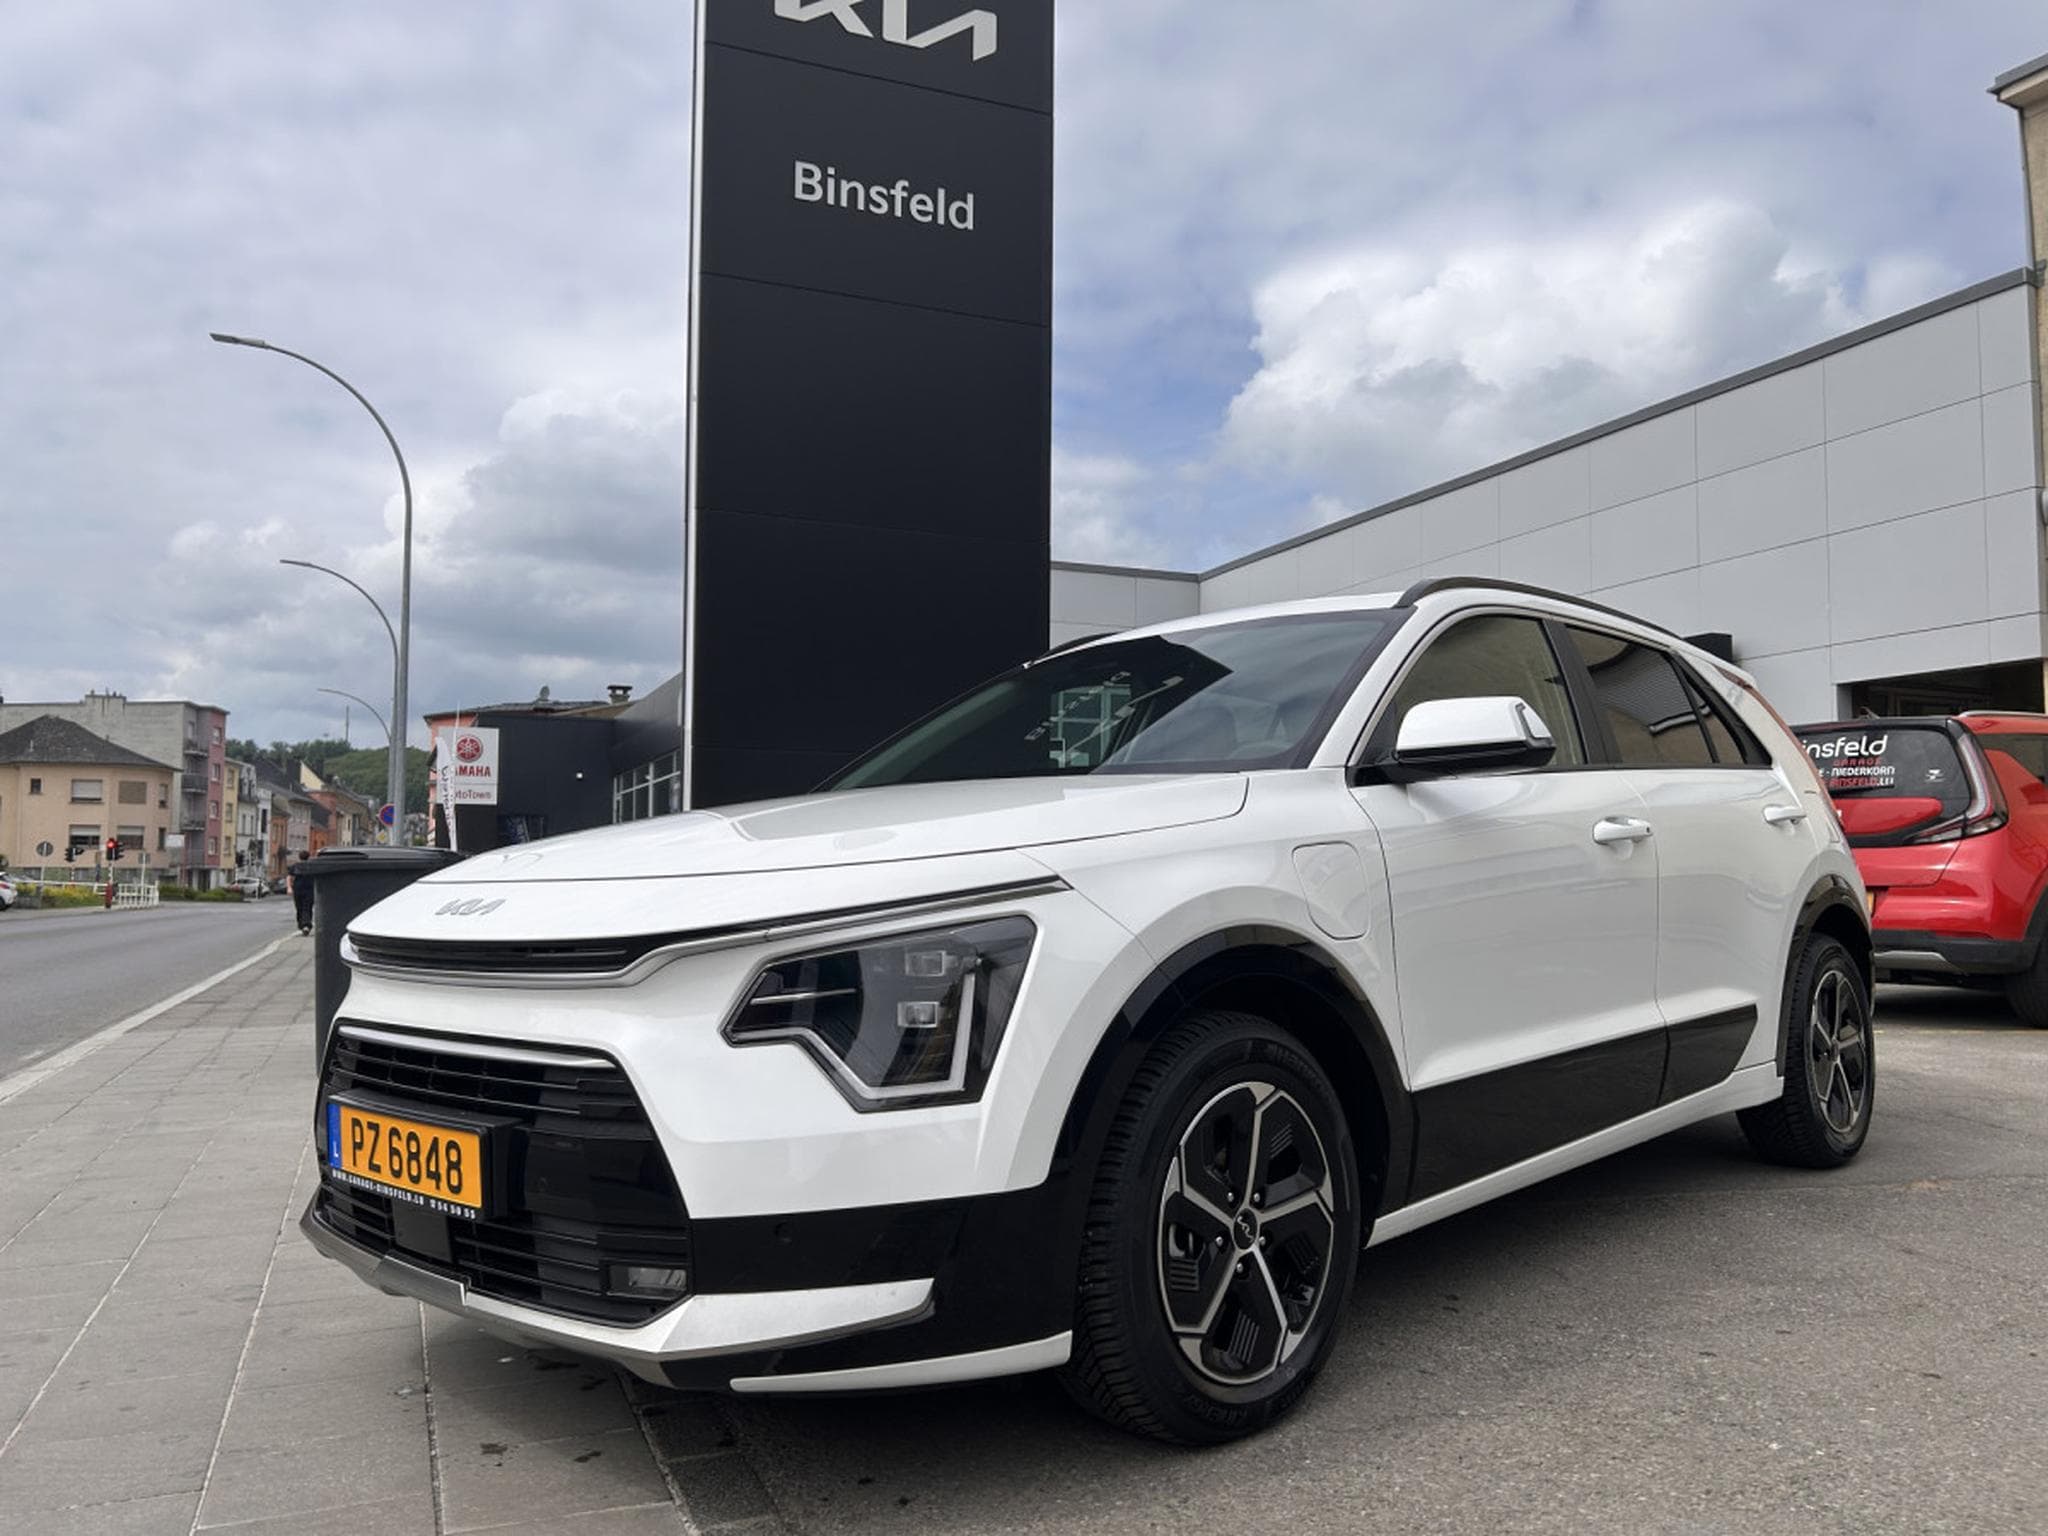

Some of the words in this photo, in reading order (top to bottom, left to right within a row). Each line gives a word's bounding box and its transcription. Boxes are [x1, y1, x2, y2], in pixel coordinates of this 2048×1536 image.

[794, 160, 975, 231] Binsfeld
[1802, 734, 1888, 758] insfeld
[455, 765, 492, 777] MAHA
[332, 1141, 340, 1158] L
